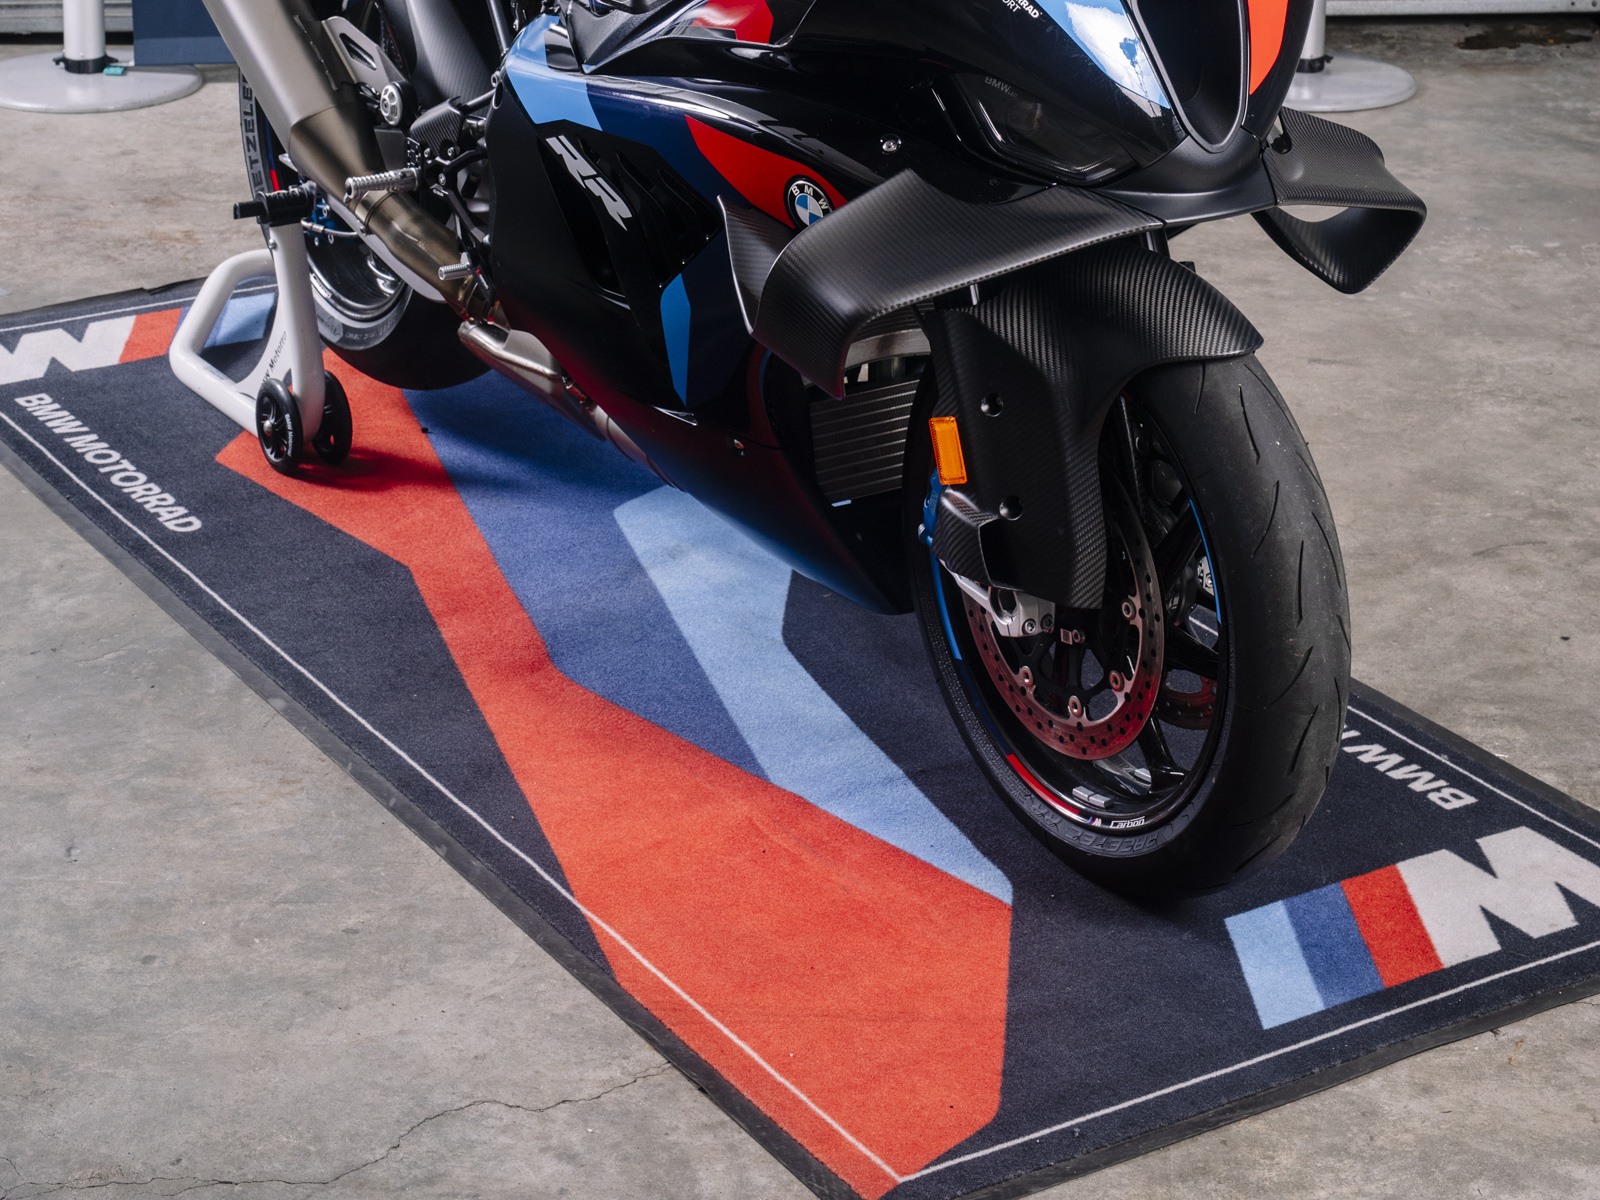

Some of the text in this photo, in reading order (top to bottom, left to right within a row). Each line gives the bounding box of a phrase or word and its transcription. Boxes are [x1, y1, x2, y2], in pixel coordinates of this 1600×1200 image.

[984, 76, 1012, 93] BMW
[242, 74, 265, 196] ETZELE
[791, 184, 829, 210] BMW
[15, 393, 202, 532] BMW MOTORRAD
[1342, 744, 1479, 810] BMW
[1110, 815, 1146, 829] Carbon
